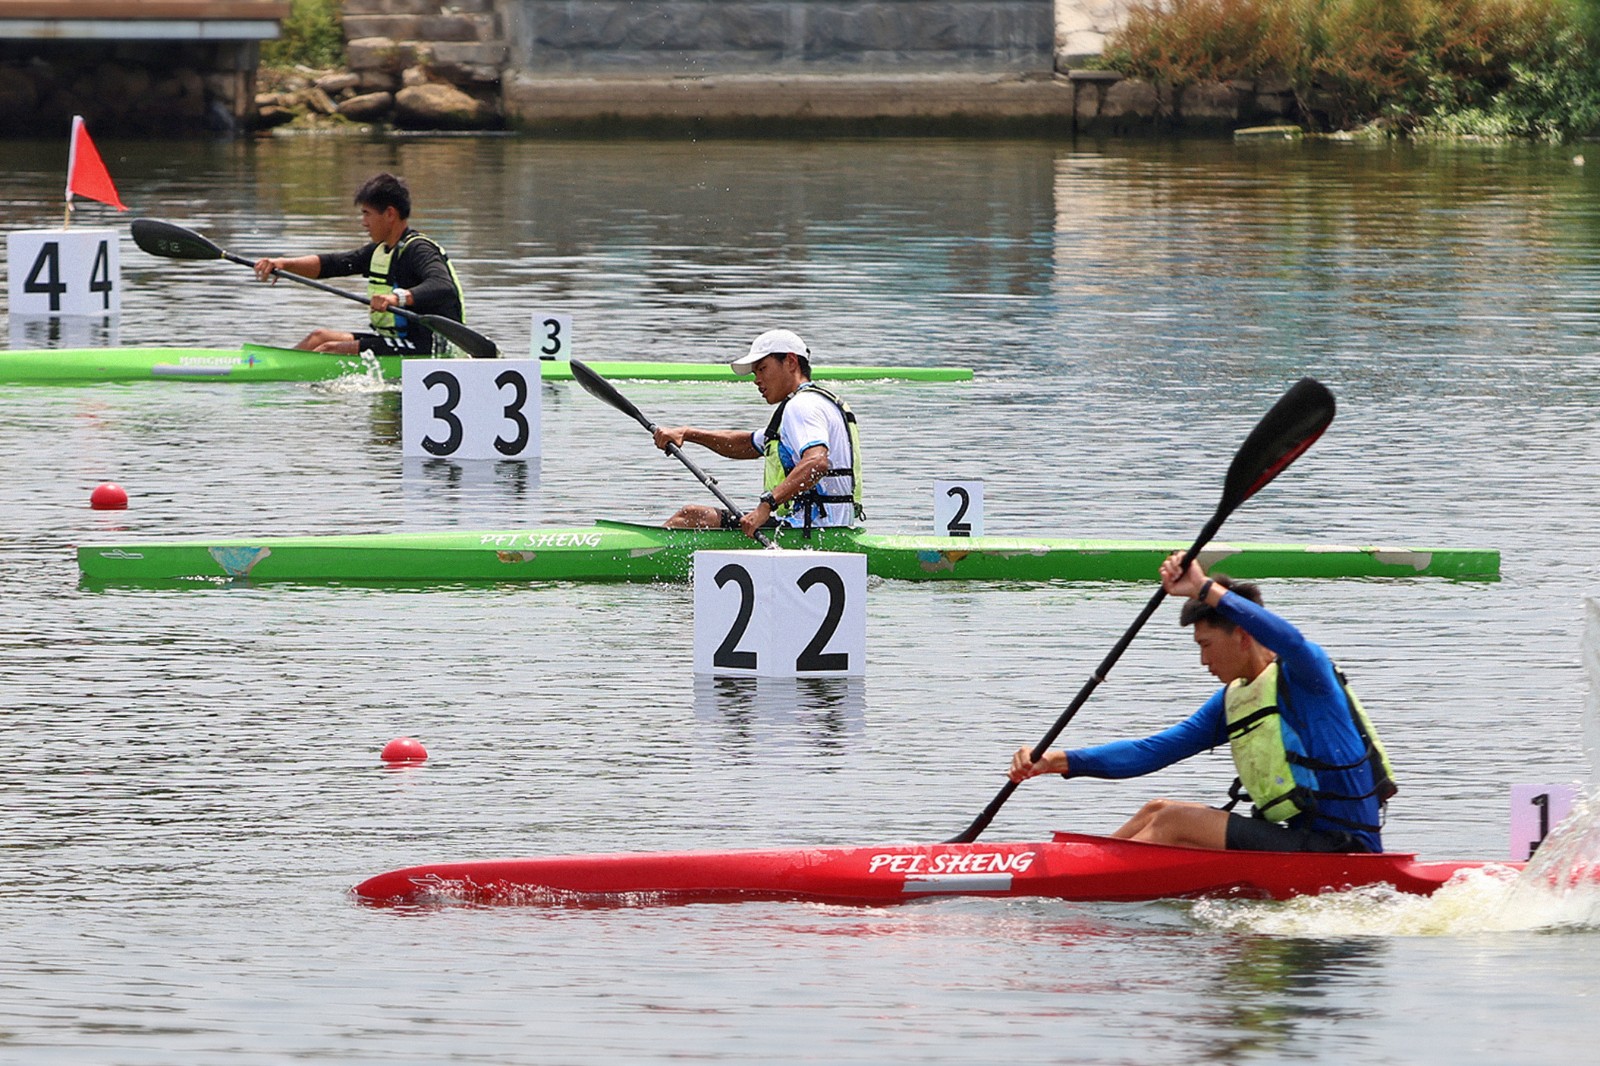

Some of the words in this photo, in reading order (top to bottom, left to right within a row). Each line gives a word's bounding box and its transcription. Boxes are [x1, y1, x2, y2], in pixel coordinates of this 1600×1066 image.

[24, 242, 67, 311] 4
[90, 240, 112, 309] 4
[541, 318, 562, 355] 3
[421, 370, 463, 456] 3
[493, 370, 529, 456] 3
[524, 532, 603, 547] SHENG
[946, 486, 972, 531] 2
[713, 563, 757, 669] 2
[796, 566, 848, 671] 2
[1530, 793, 1549, 850] 1
[869, 854, 927, 873] PEI
[928, 851, 1036, 873] SHENG
